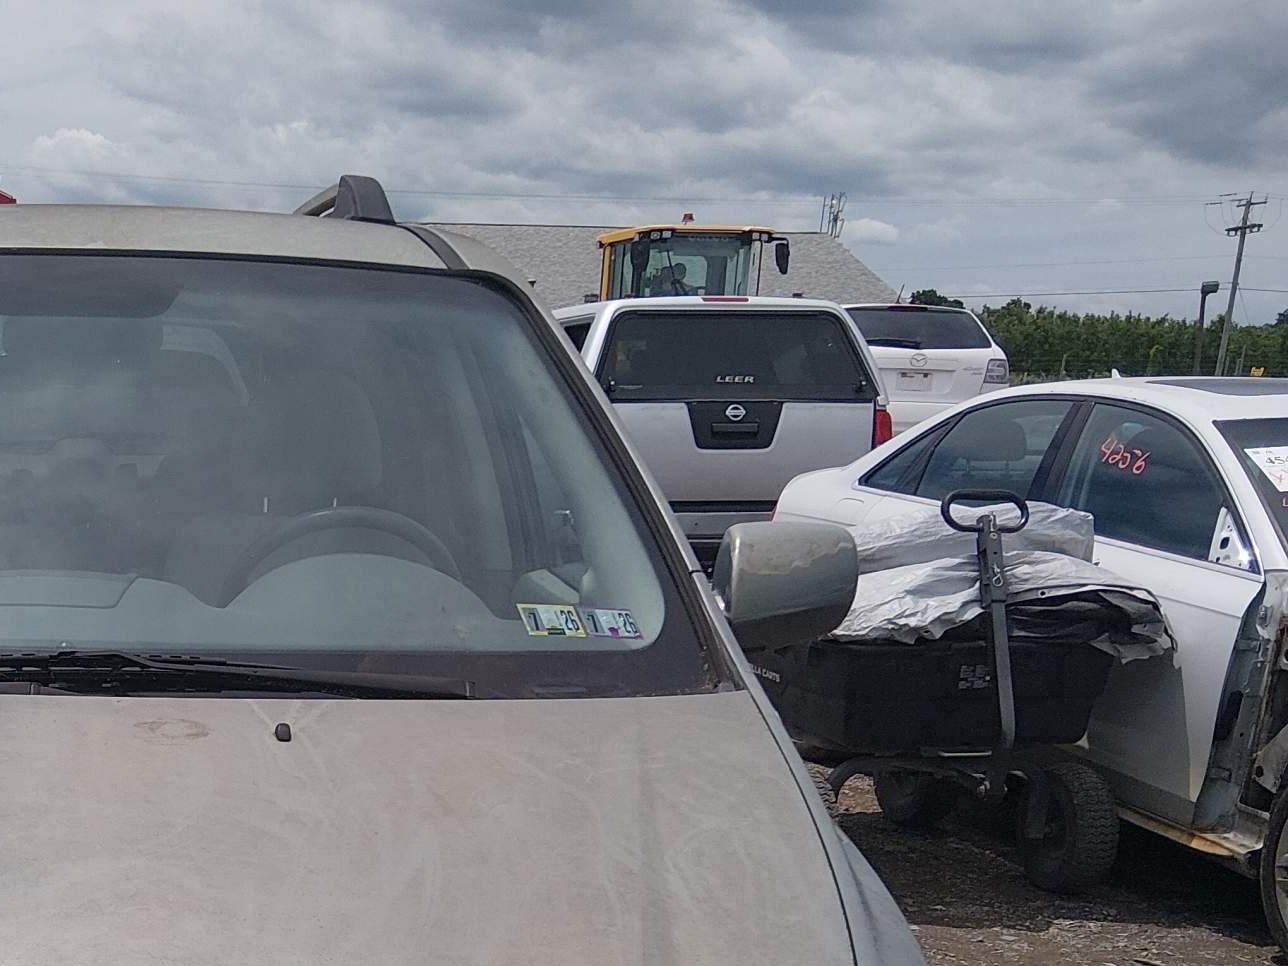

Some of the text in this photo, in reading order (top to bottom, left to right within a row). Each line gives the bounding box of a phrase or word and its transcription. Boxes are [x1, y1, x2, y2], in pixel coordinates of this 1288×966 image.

[716, 375, 754, 383] LEER
[560, 610, 580, 631] 26
[618, 613, 638, 634] 26
